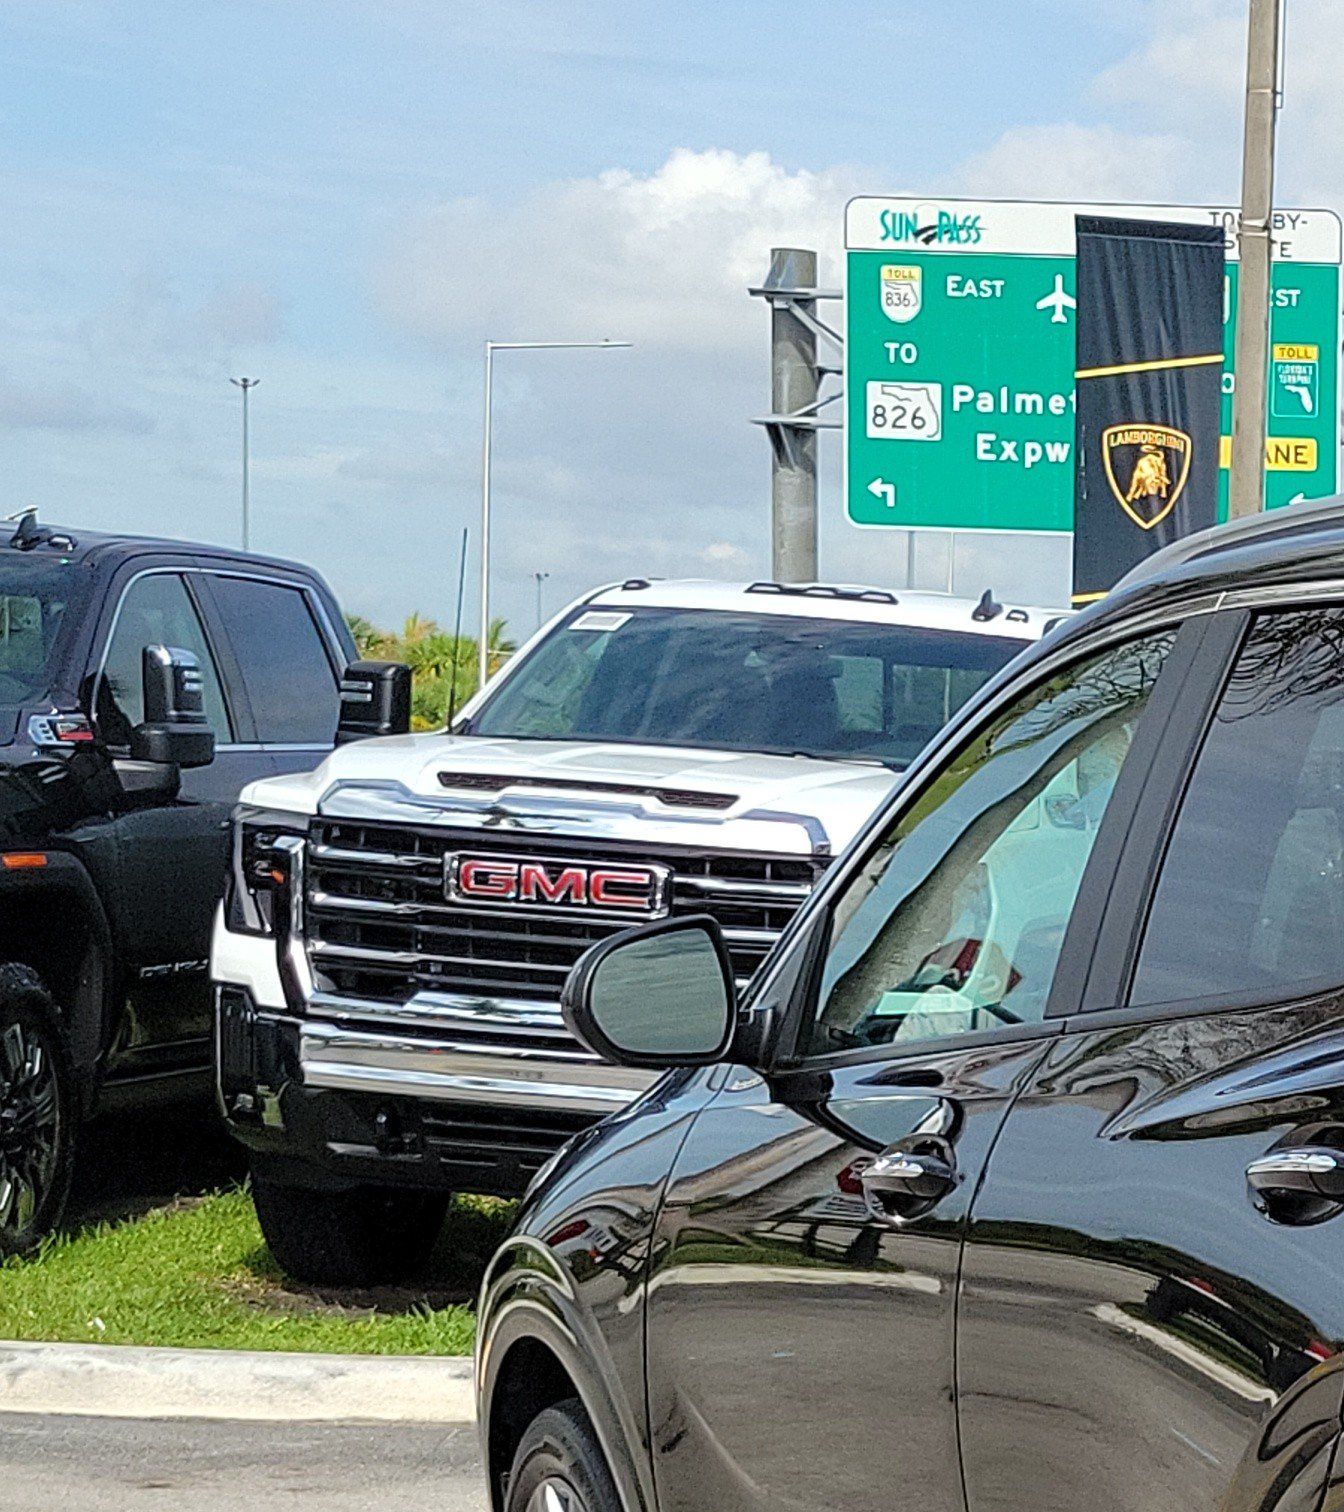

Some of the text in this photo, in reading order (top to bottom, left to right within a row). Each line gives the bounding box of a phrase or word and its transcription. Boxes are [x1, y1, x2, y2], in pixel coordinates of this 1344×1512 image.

[1273, 213, 1308, 230] BY-
[887, 268, 916, 279] TOLL
[946, 275, 1005, 298] EAST
[885, 292, 911, 307] 836
[884, 342, 918, 364] TO
[1278, 347, 1312, 359] TOLL
[952, 384, 1076, 415] Palme
[872, 404, 926, 430] 826
[976, 432, 1071, 469] Expw
[1266, 444, 1309, 465] NE
[460, 860, 653, 909] GMC
